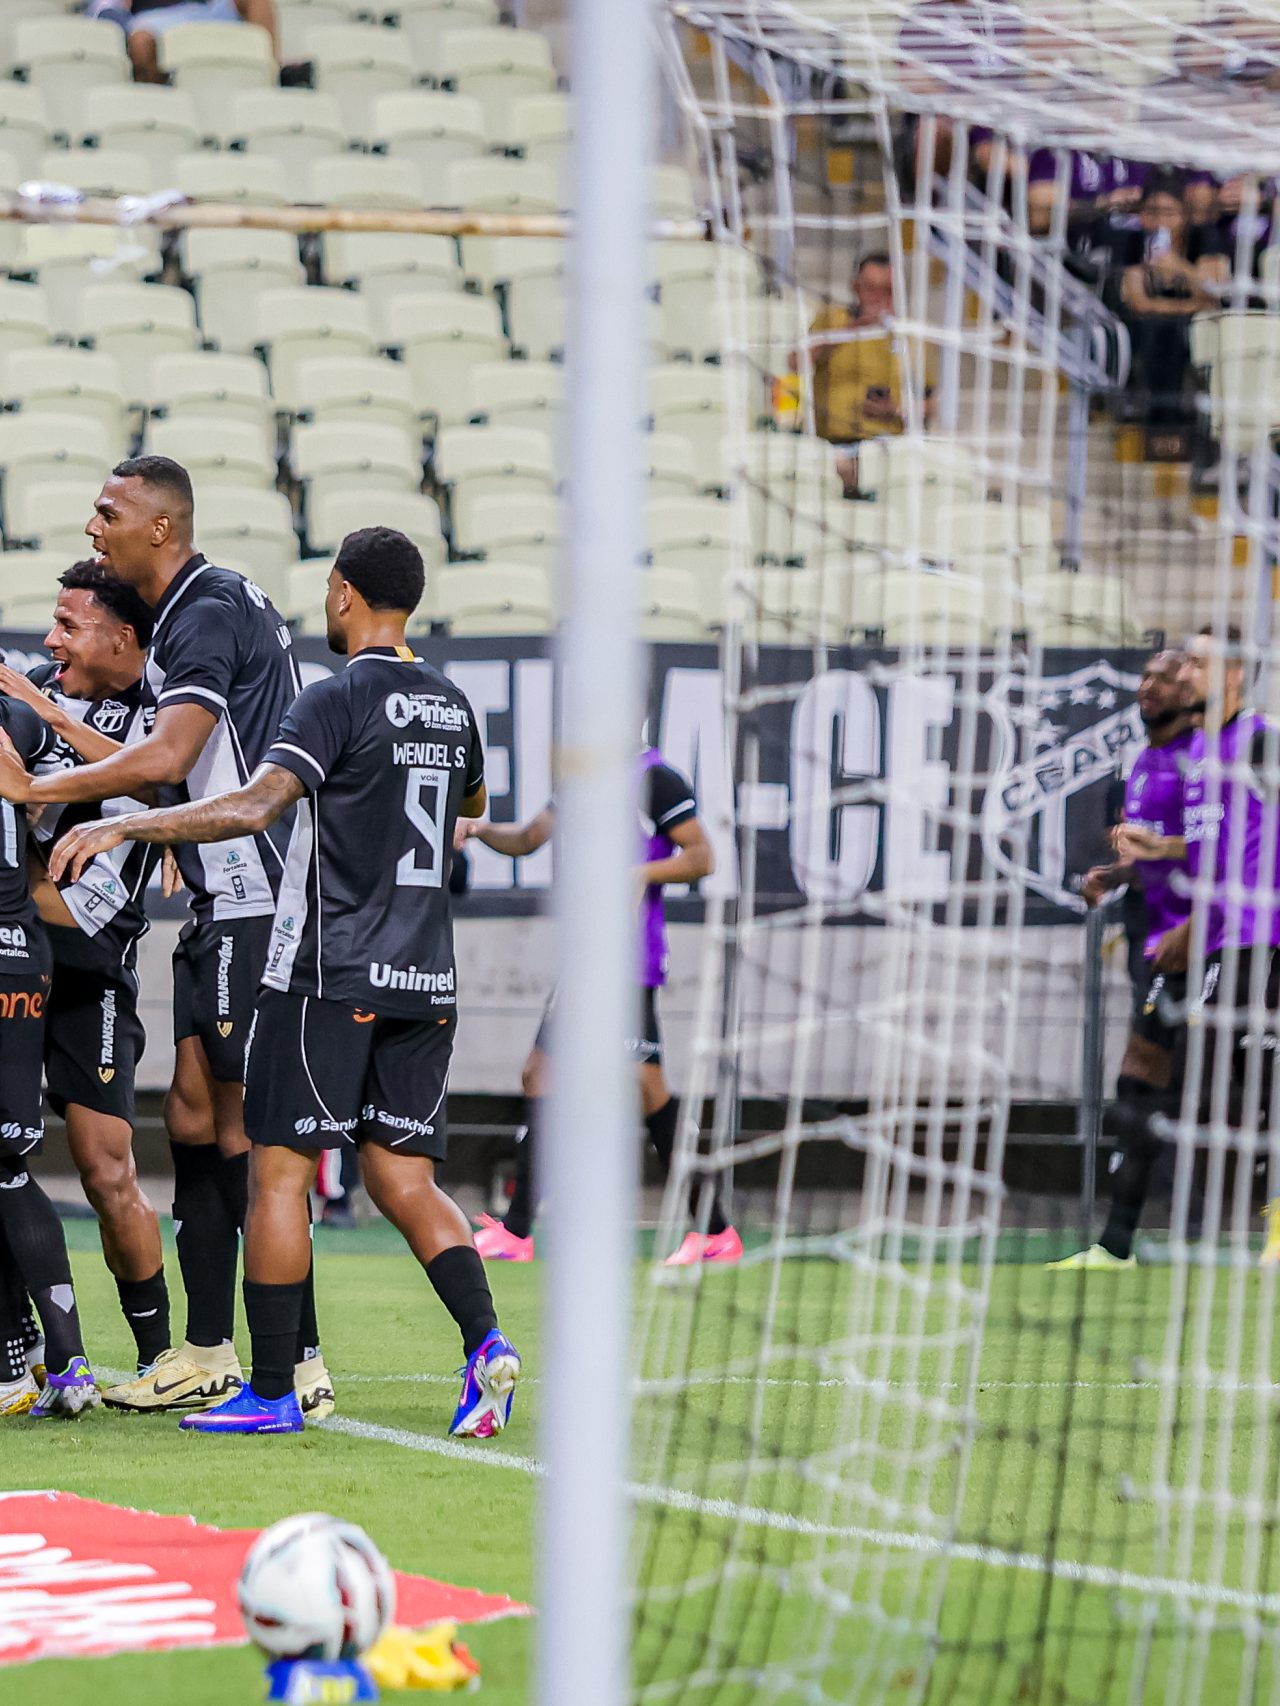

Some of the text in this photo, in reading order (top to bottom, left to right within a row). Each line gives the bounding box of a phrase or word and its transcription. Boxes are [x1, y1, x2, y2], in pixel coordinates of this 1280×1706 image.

[408, 699, 470, 728] Pinheiro
[392, 742, 466, 769] WENDEL S.
[395, 767, 451, 889] 9
[369, 962, 455, 992] Unimed
[377, 1110, 435, 1136] Sankhya
